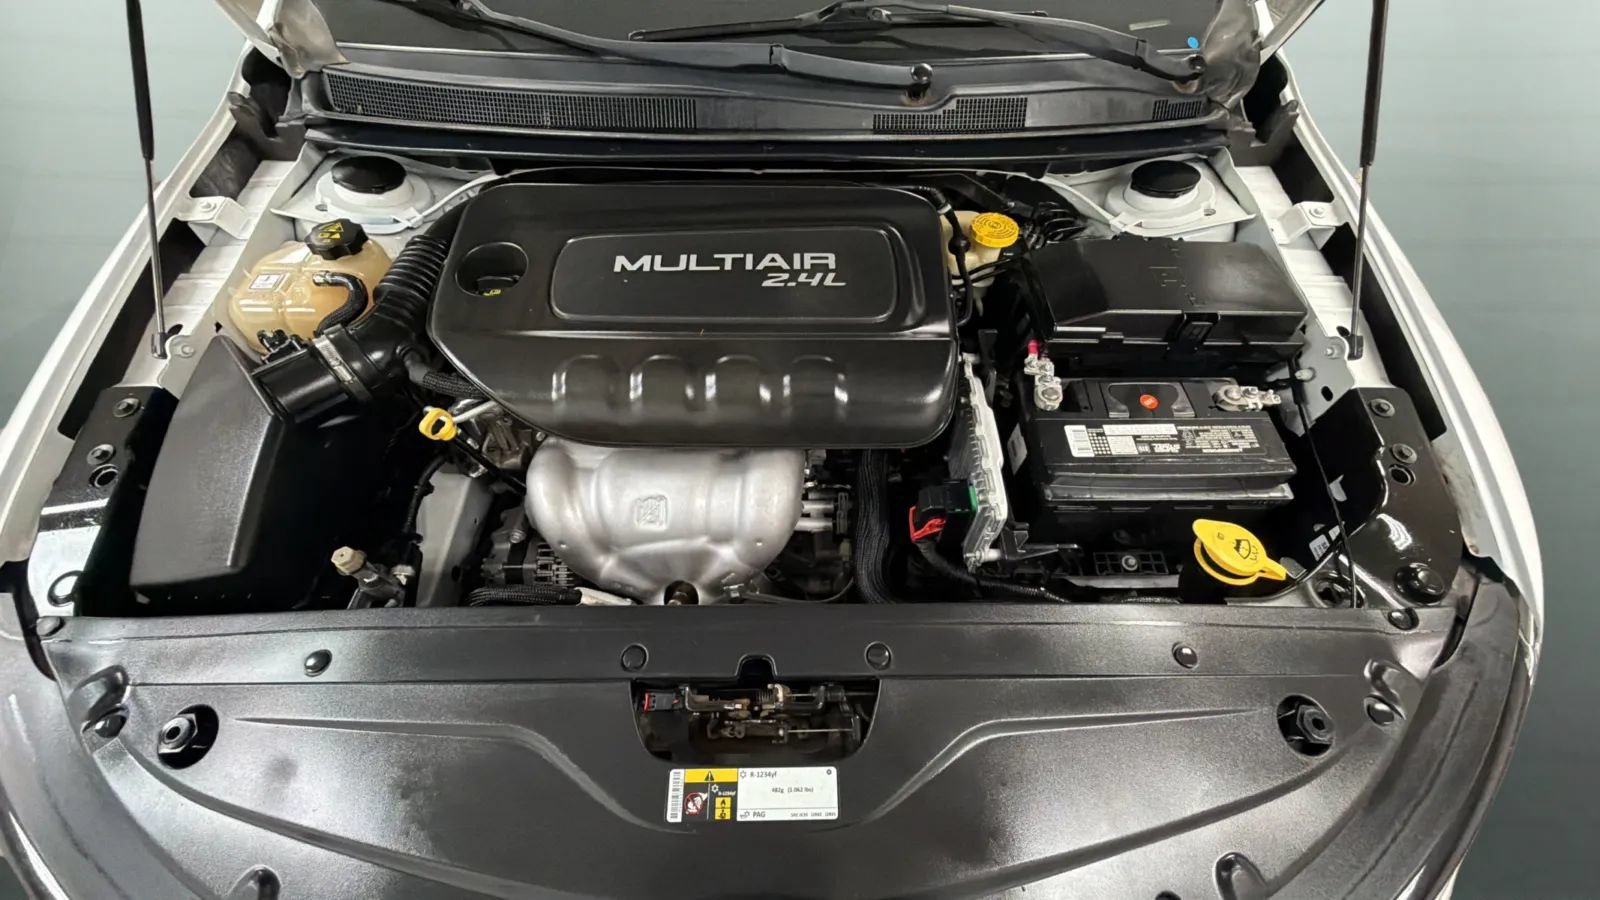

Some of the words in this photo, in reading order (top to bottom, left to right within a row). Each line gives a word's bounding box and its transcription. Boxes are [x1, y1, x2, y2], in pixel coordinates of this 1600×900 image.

[613, 252, 836, 272] MULTIAIR
[761, 272, 847, 287] 2.4L
[750, 771, 777, 779] R-1234yf
